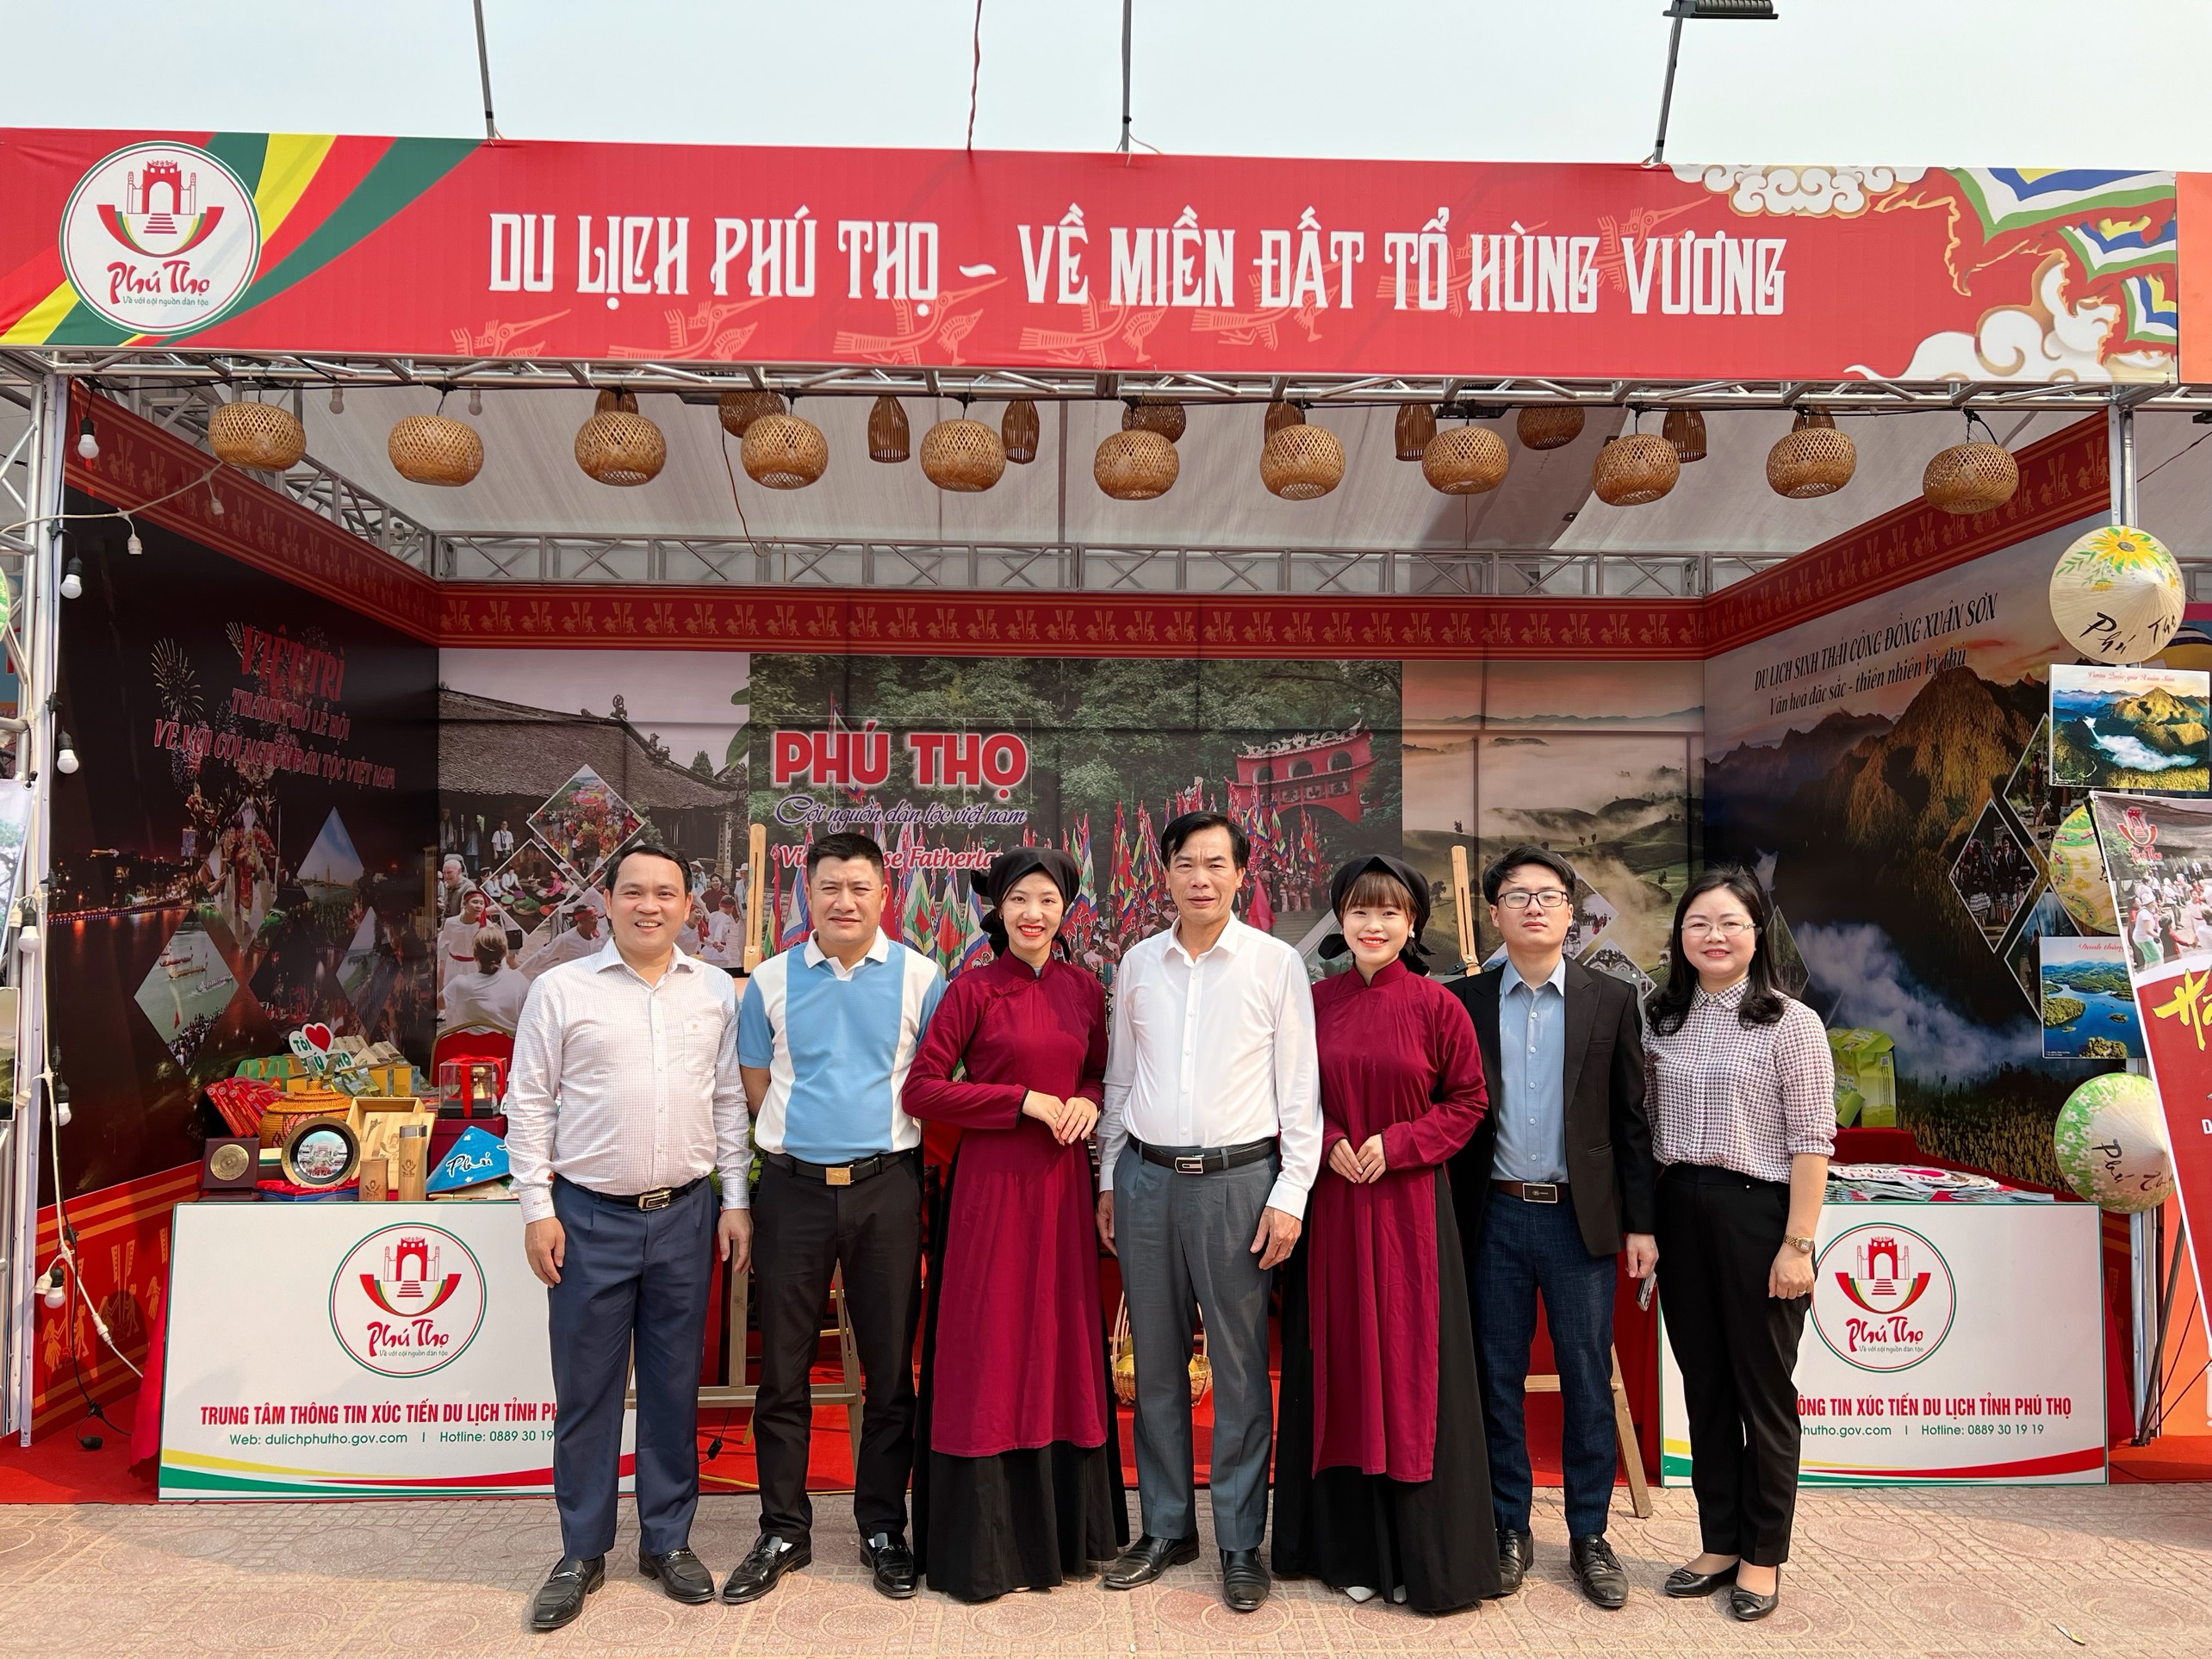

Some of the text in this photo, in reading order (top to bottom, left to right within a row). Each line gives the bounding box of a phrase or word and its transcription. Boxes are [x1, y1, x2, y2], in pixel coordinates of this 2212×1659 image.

[488, 214, 556, 292] DU
[577, 215, 689, 310] LỊCH
[714, 204, 817, 297] PHÚ
[837, 220, 939, 317] THỌ
[1017, 202, 1089, 304] VỀ
[1109, 206, 1237, 308] MIỀN
[1252, 205, 1364, 309] ĐẤT
[1384, 206, 1448, 312] TỔ
[1469, 221, 1599, 314] HÙNG
[1620, 229, 1786, 316] VƯƠNG
[107, 260, 210, 304] Phú Thọ
[1755, 592, 1998, 691] DU LỊCH SINH THÁI CỘNG ĐỒNG XUÂN SƠN
[308, 646, 345, 702] TRÌ
[1809, 684, 1827, 709] đặc
[1829, 674, 1847, 700] sắc
[1855, 667, 1885, 693] thiên
[1887, 656, 1922, 685] nhiên
[1942, 641, 1967, 672] thú
[153, 709, 180, 750] VỀ
[322, 749, 345, 785] TỘC
[372, 764, 396, 790] NAM
[775, 722, 1028, 799] PHÚ THỌ
[828, 798, 881, 834] nguồn
[885, 802, 921, 825] dân
[923, 800, 951, 827] tộc
[954, 799, 985, 827] việt
[988, 809, 1027, 825] nam
[293, 1036, 312, 1052] TÔI
[367, 1319, 449, 1357] Phú Thọ
[1846, 1316, 1923, 1352] Phú Thọ
[201, 1397, 557, 1426] TRUNG TÂM THÔNG TIN XÚC TIẾN DU LỊCH TỈNH PH
[1830, 1398, 1852, 1416] TIN
[1856, 1395, 1884, 1416] XÚC
[1888, 1393, 1918, 1416] TIẾN
[1923, 1398, 1941, 1415] DU
[1946, 1398, 1975, 1420] LỊCH
[1979, 1392, 2010, 1415] TỈNH
[2015, 1394, 2041, 1415] PHÚ
[2046, 1398, 2072, 1419] THỌ
[230, 1434, 261, 1445] Web:
[265, 1432, 407, 1447] dulichphutho.gov.com
[440, 1431, 486, 1443] Hotline:
[489, 1431, 518, 1442] 0889
[521, 1430, 536, 1442] 30
[541, 1430, 555, 1441] 19
[1922, 1425, 1964, 1435] Hotline:
[1967, 1425, 1994, 1435] 0889
[1998, 1425, 2011, 1435] 30
[2016, 1424, 2028, 1434] 19
[2032, 1424, 2044, 1434] 19
